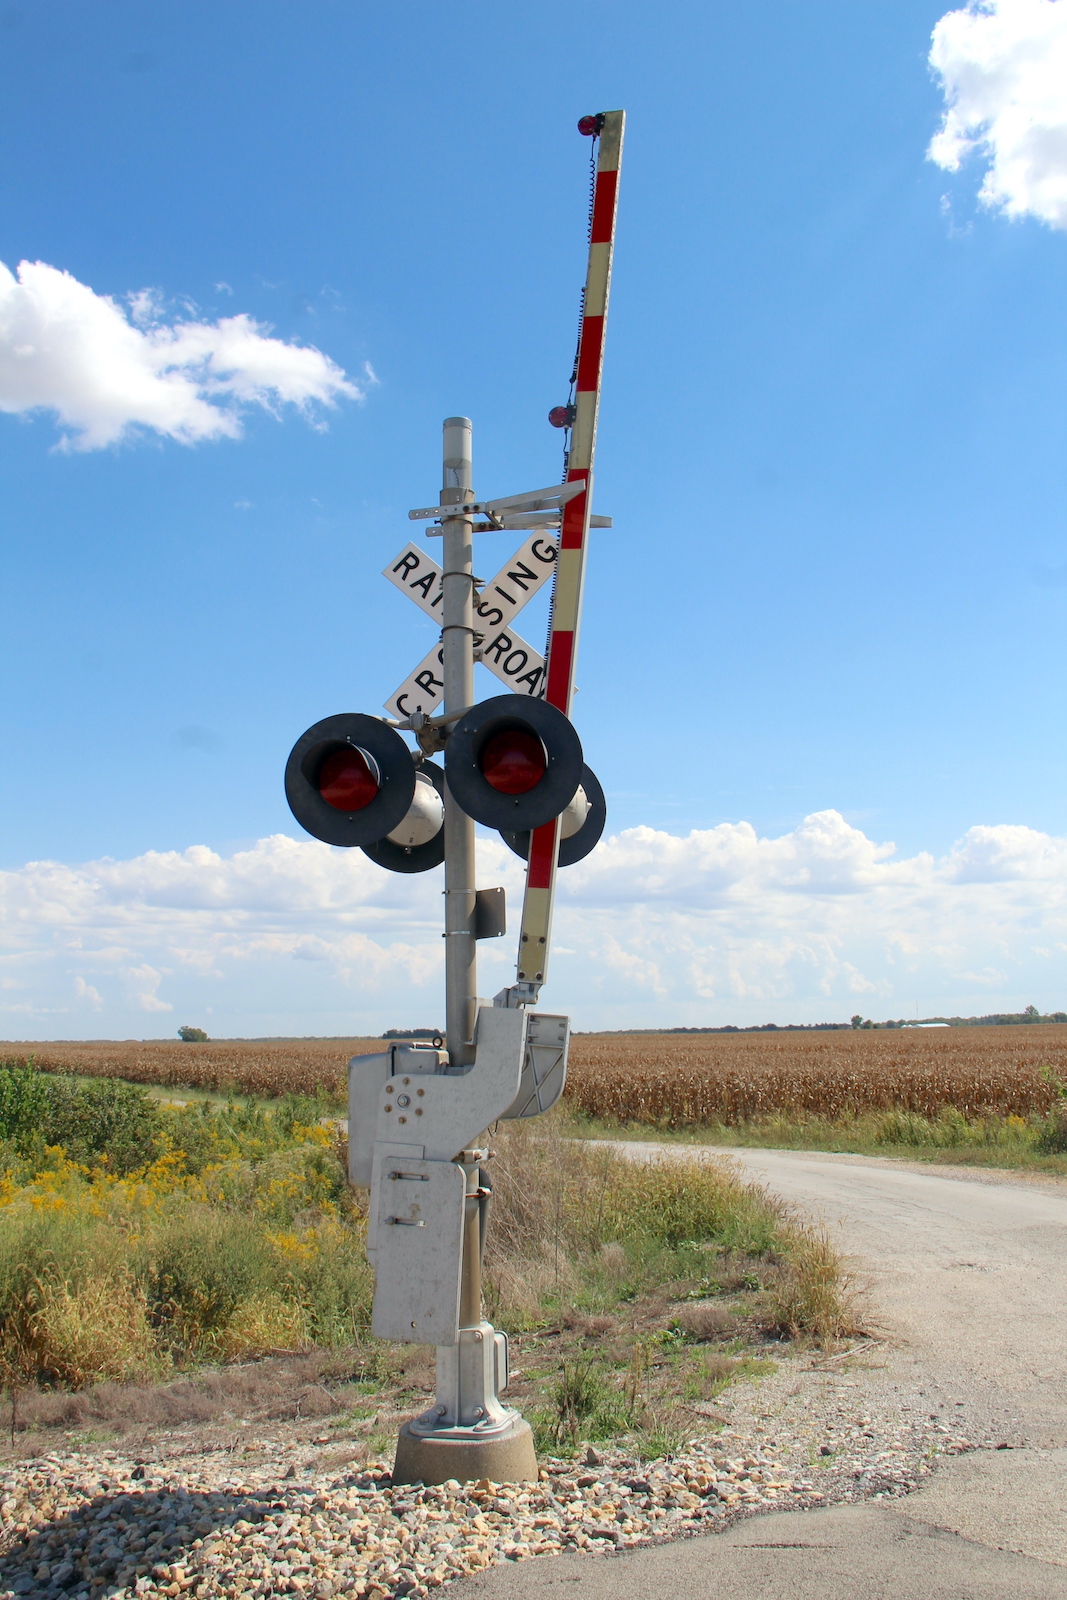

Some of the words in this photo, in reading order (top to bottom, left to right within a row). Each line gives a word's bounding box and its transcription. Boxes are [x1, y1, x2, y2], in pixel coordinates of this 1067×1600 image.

[392, 551, 444, 616] RAI
[484, 632, 545, 698] ROA
[396, 539, 558, 717] CRSING
